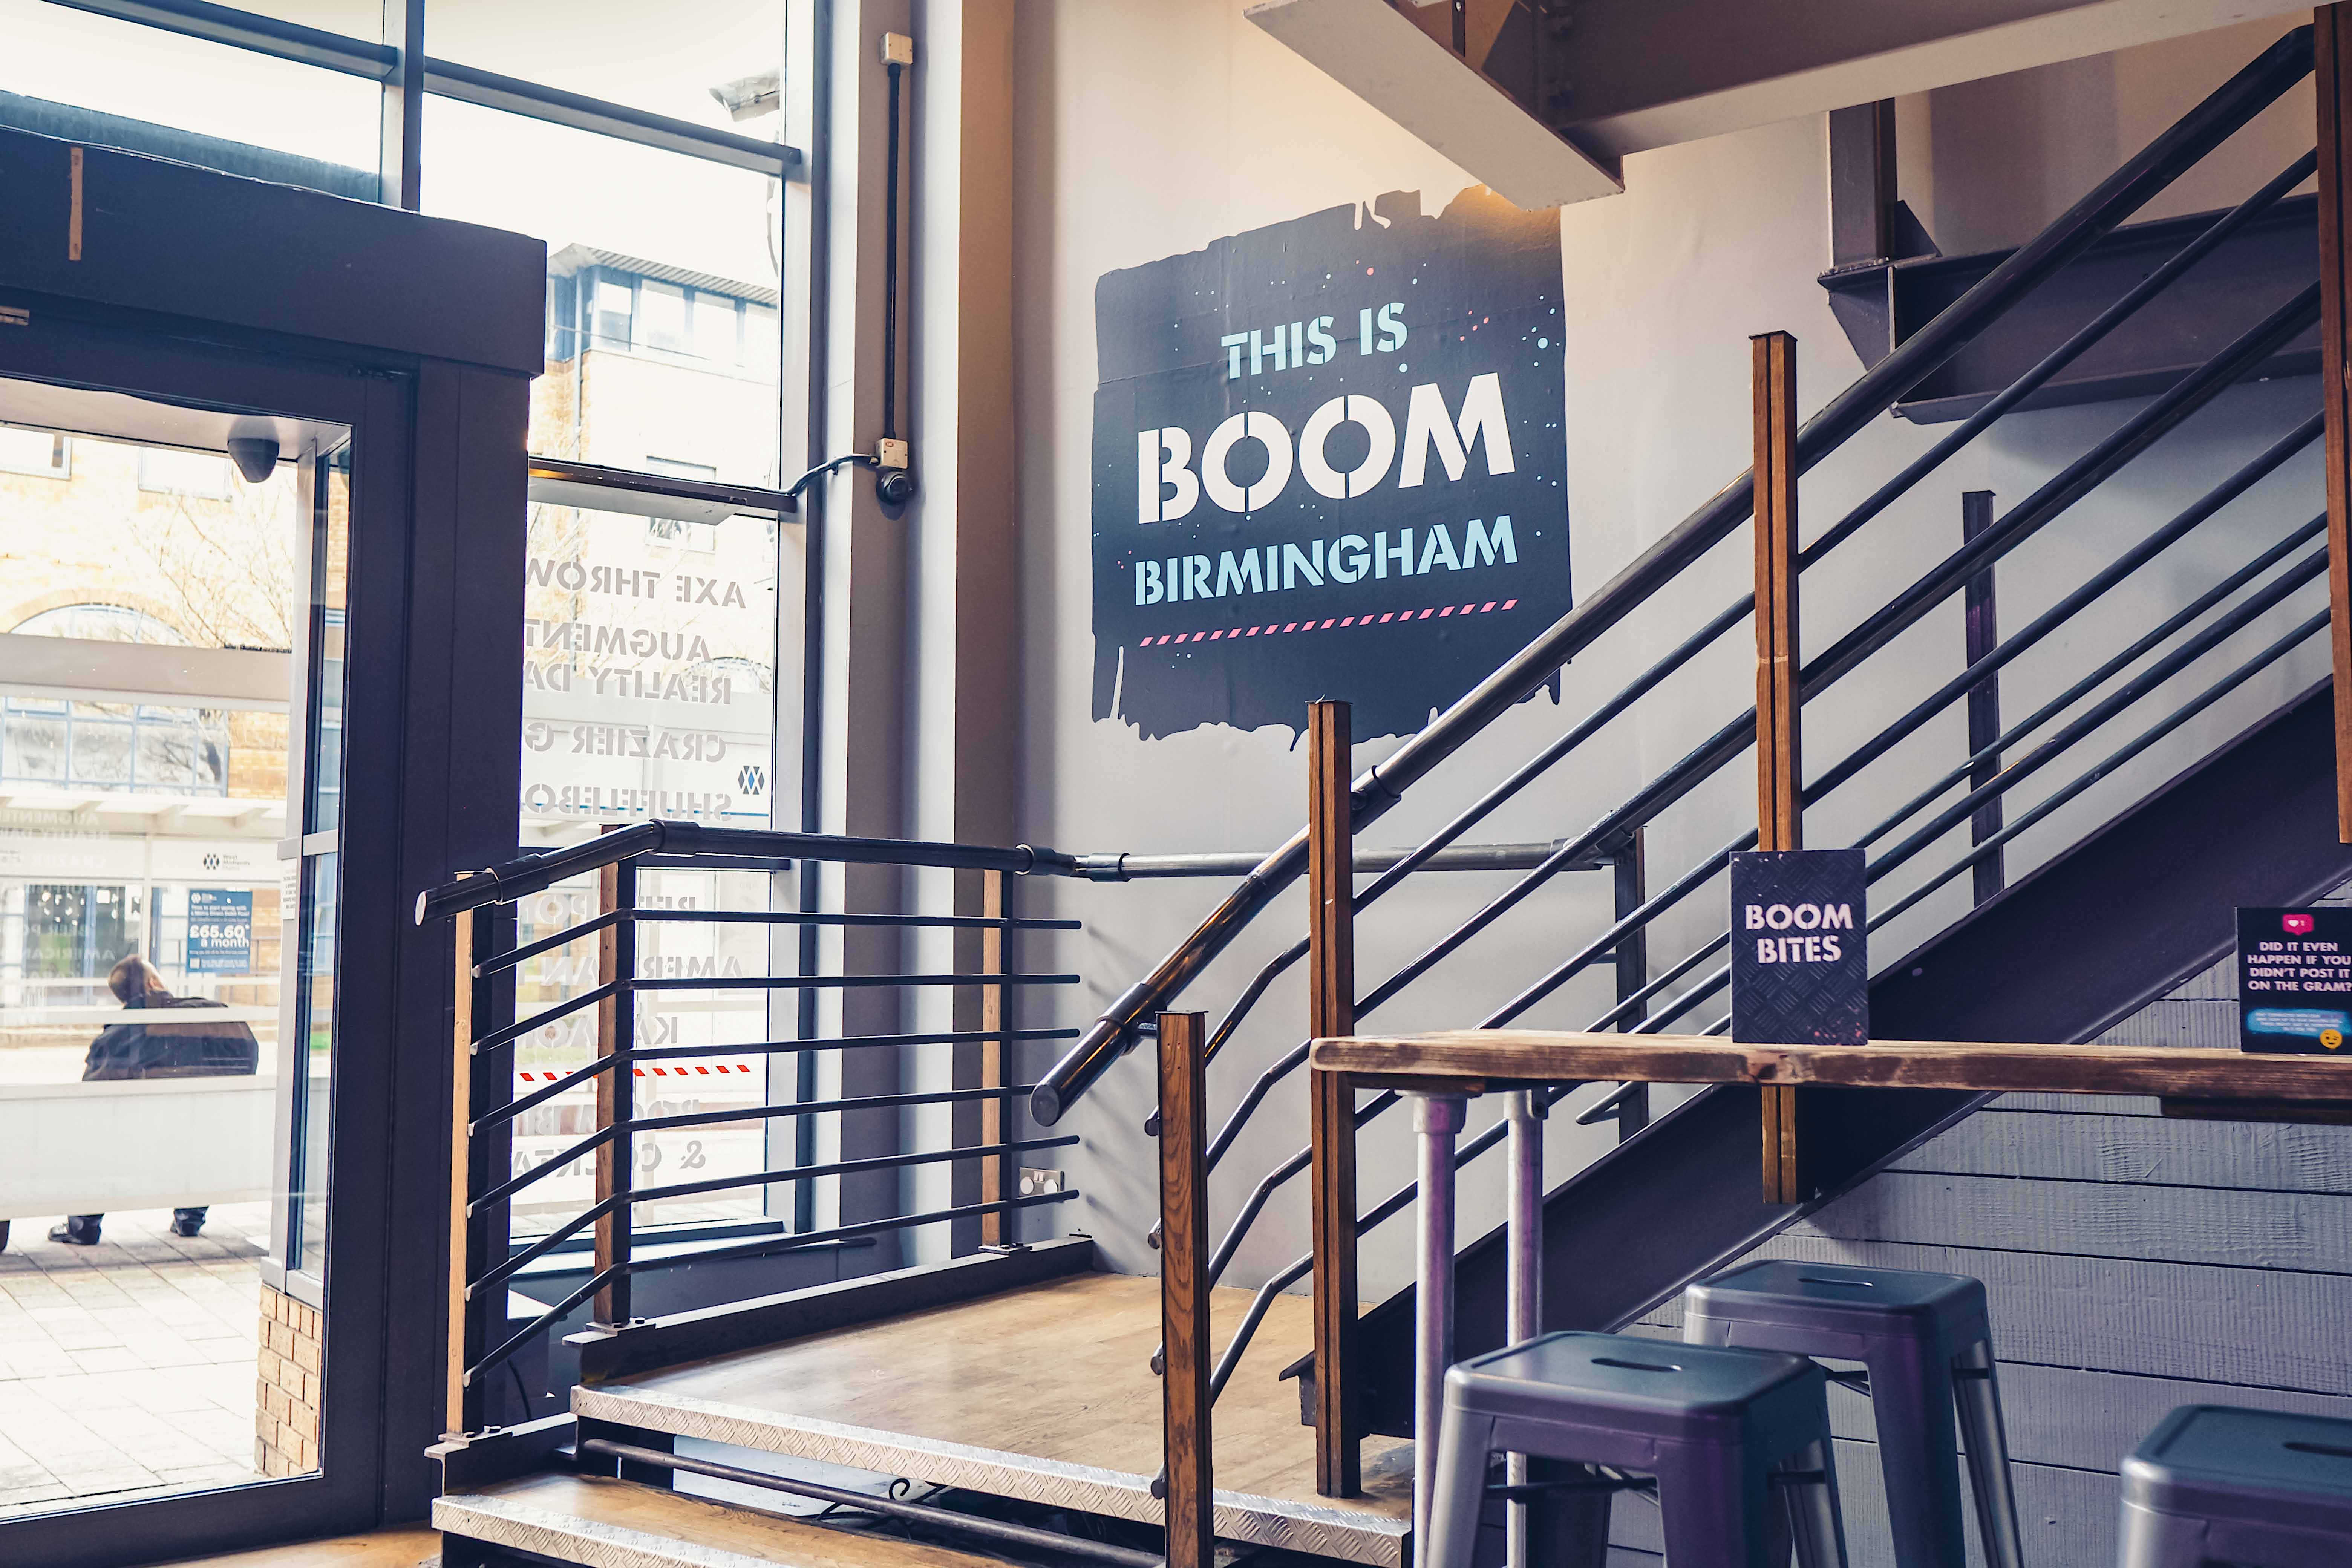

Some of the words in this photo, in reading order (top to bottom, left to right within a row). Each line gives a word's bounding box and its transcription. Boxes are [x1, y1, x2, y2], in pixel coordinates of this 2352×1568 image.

[1221, 316, 1337, 379] THIS
[1360, 302, 1408, 355] IS
[1138, 372, 1516, 525] BOOM
[1135, 514, 1518, 605] BIRMINGHAM
[1745, 903, 1853, 930] BOOM
[211, 937, 249, 948] month
[1757, 935, 1842, 964] BITES
[2260, 942, 2283, 951] DID
[2287, 942, 2299, 951] IT
[2303, 942, 2338, 952] EVEN
[2248, 955, 2301, 964] HAPPEN
[2306, 955, 2318, 965] IF
[2322, 956, 2351, 965] YOU
[2250, 968, 2295, 977] DIDN'T
[2300, 968, 2334, 978] POST
[2338, 968, 2350, 978] IT
[2248, 981, 2271, 990] ON
[2274, 981, 2299, 991] THE
[2303, 982, 2352, 992] GRAM?
